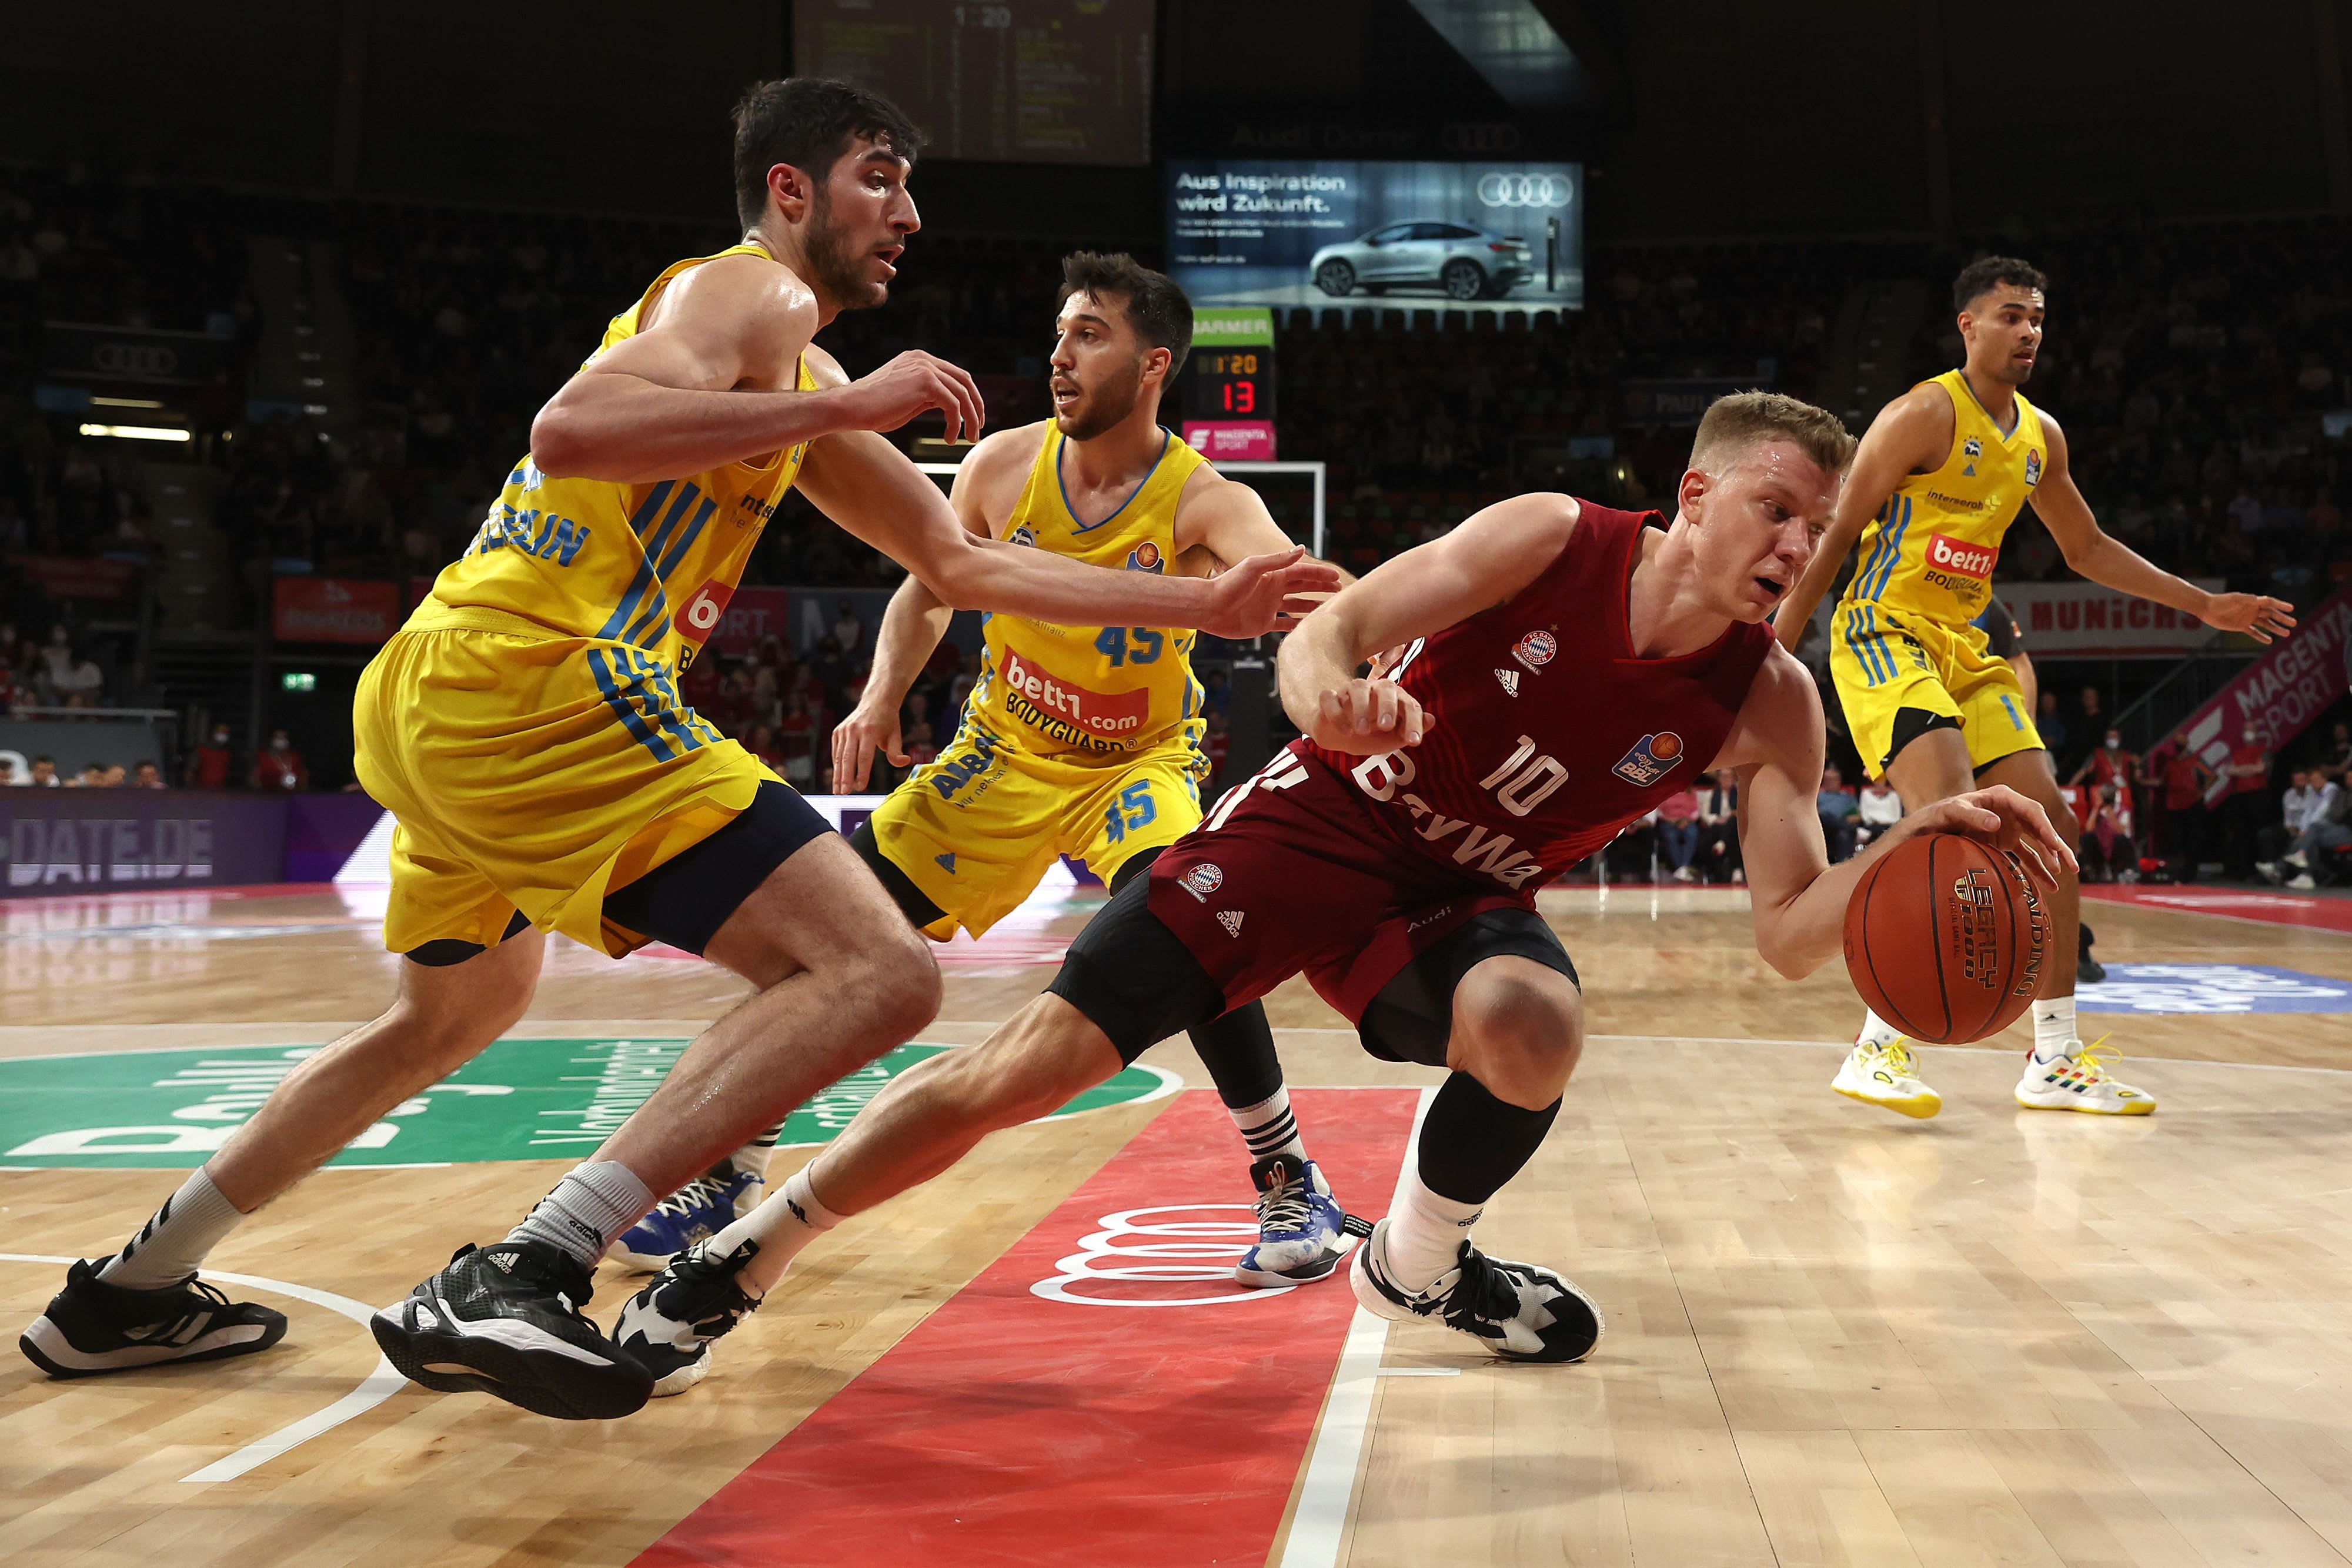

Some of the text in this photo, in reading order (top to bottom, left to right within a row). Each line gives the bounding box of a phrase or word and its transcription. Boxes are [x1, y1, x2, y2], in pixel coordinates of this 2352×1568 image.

[1177, 172, 1346, 194] Aus Inspiration
[1177, 194, 1330, 212] wird Zukunft.
[1193, 320, 1267, 334] ARMER
[1224, 380, 1255, 413] 13
[1094, 626, 1164, 668] 45
[1539, 633, 1554, 654] BAYERN
[1512, 650, 1540, 675] BASKETBALL
[2234, 601, 2352, 721] MAGENTA
[1494, 668, 1518, 698] adidas
[2254, 663, 2333, 749] SPORT
[930, 737, 995, 800] ALBA
[1479, 735, 1568, 817] 10
[1618, 762, 1652, 783] BBL
[1351, 748, 1543, 891] BayWa
[1207, 865, 1221, 884] BAYERN
[1178, 880, 1205, 903] BASKETBALL
[1216, 912, 1240, 938] adidas
[1406, 907, 1451, 933] Audi
[1966, 868, 1997, 989] LEGACY
[1960, 904, 1975, 979] 1000
[487, 1254, 512, 1275] adidas
